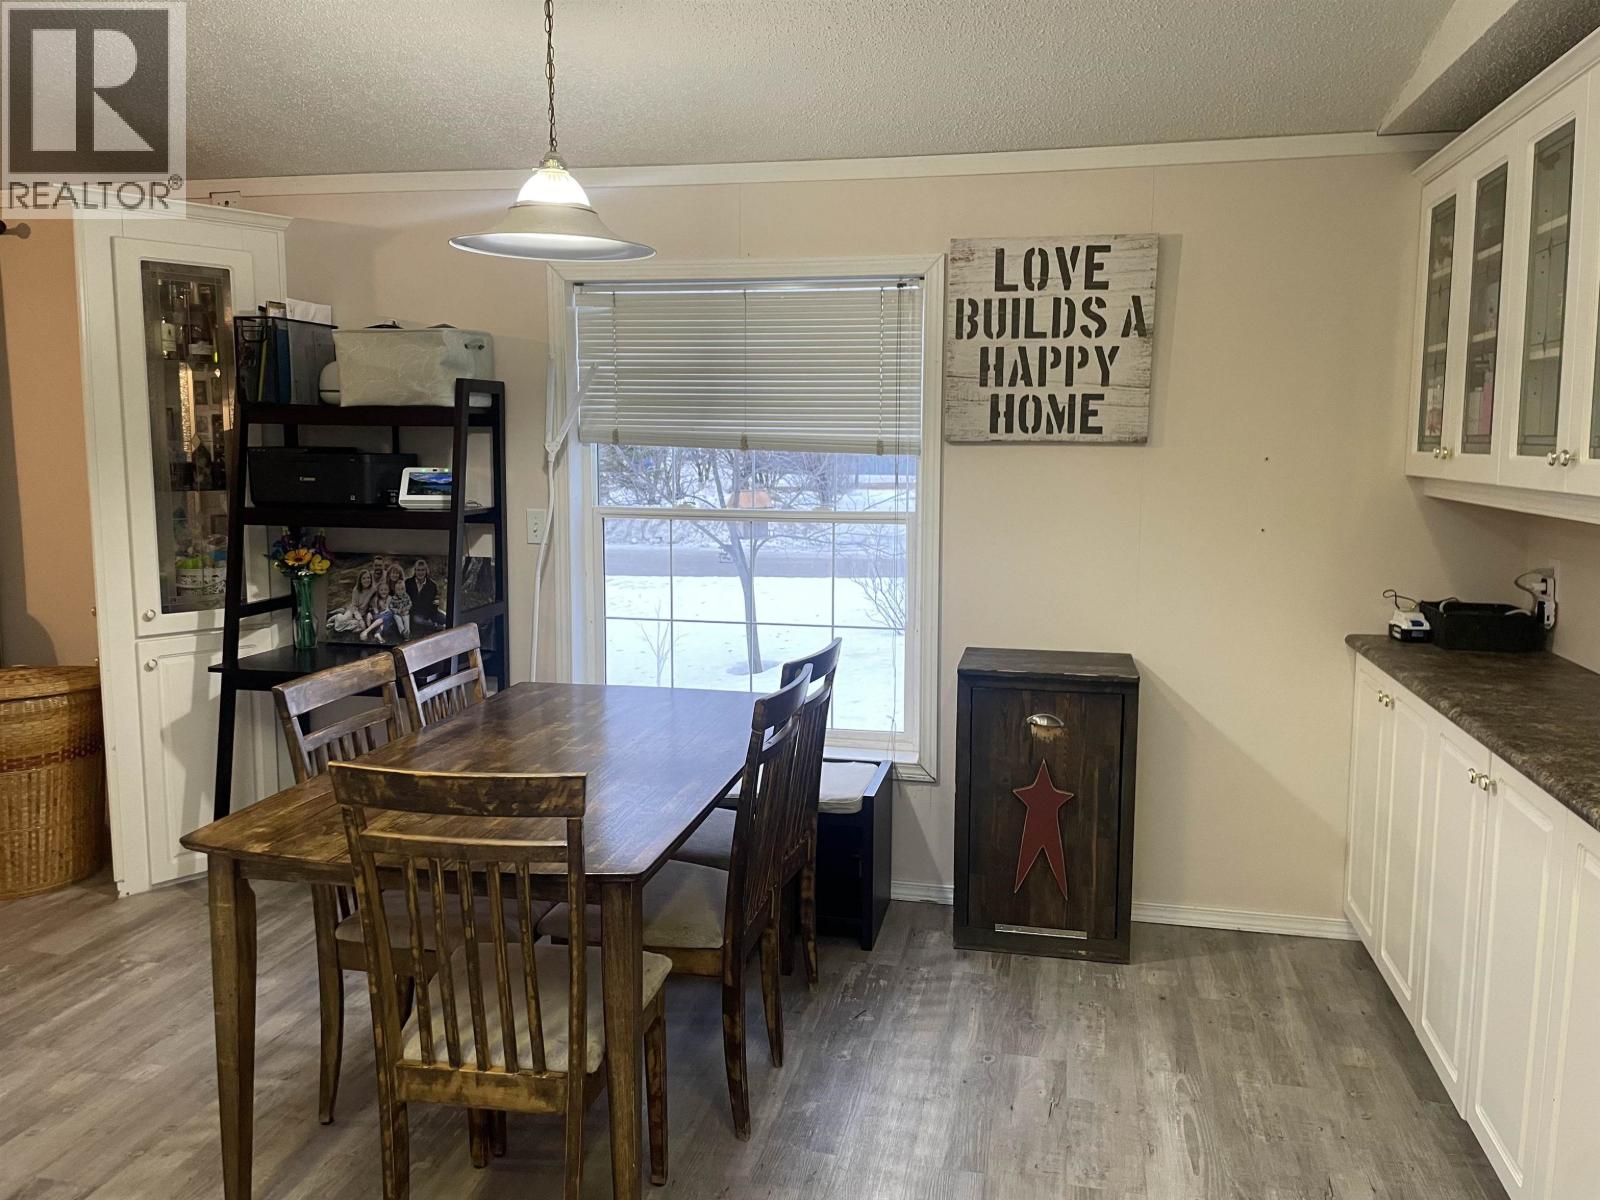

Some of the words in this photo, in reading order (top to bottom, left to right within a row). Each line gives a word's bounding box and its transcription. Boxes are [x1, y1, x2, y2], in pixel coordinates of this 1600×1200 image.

[994, 245, 1111, 291] LOVE
[955, 296, 1107, 339] BUILDS
[1120, 295, 1147, 337] A
[979, 345, 1120, 387] HAPPY
[989, 393, 1104, 434] HOME
